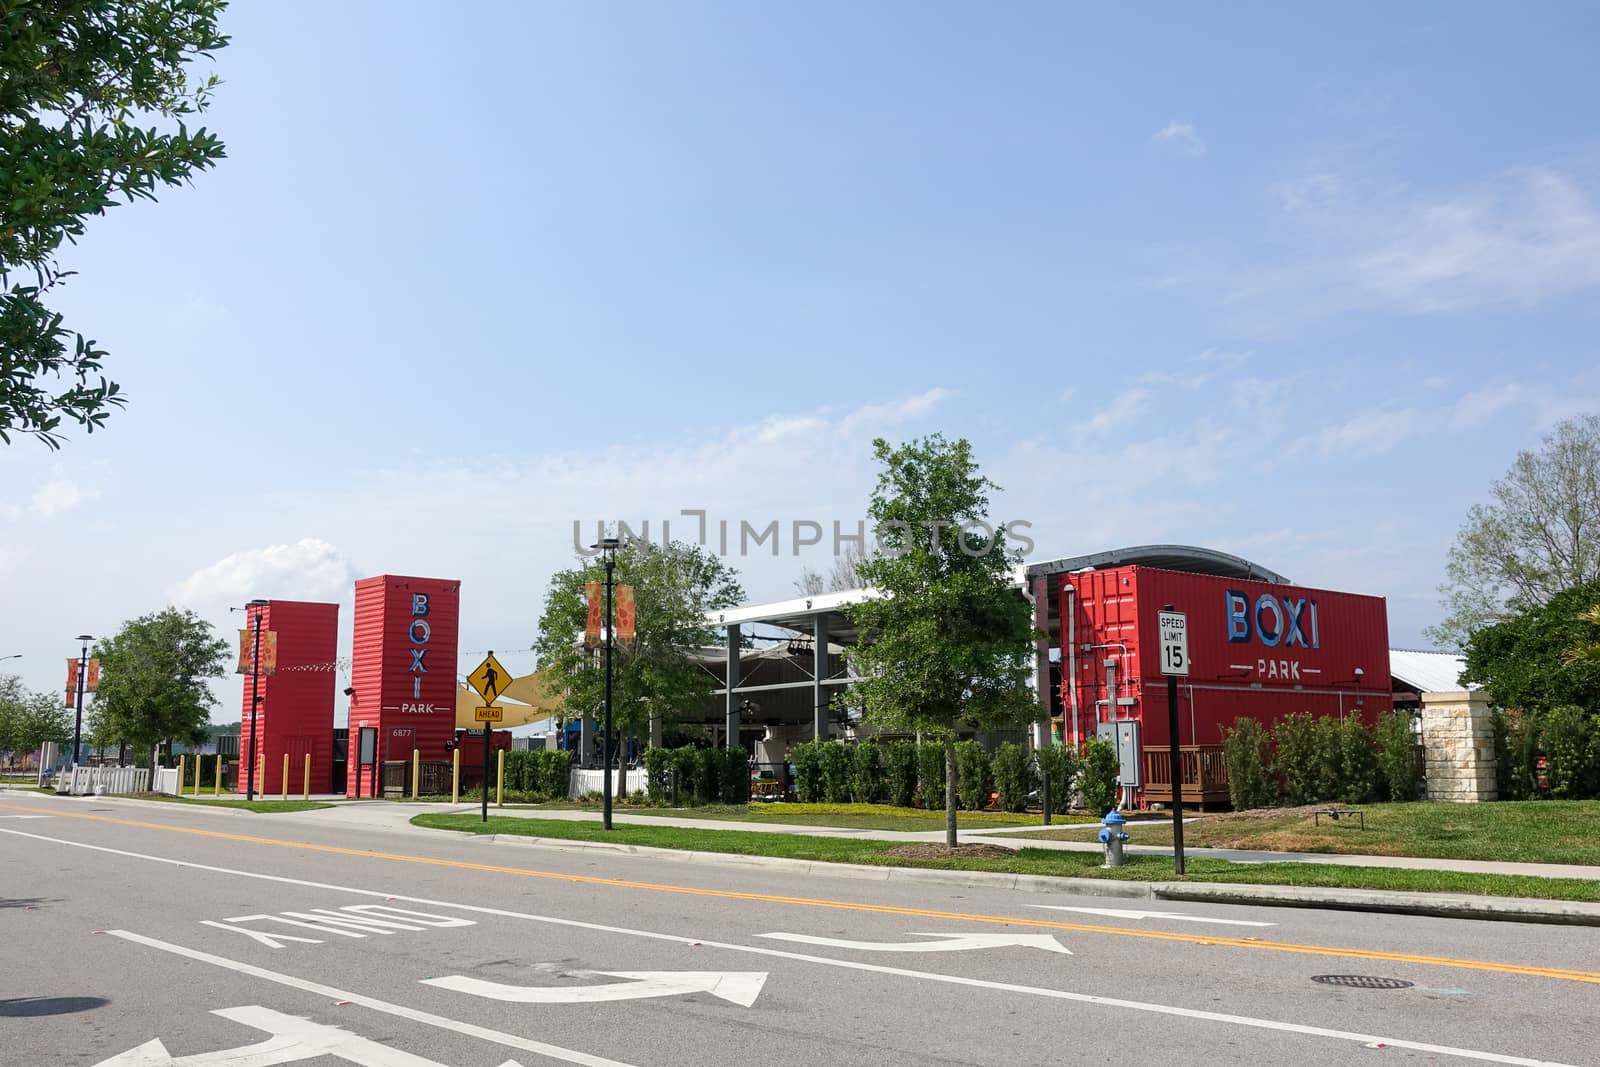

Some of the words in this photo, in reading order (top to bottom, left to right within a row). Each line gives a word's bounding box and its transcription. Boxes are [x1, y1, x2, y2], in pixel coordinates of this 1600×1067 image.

[1161, 617, 1184, 629] SPEED
[1225, 589, 1320, 649] BOXI
[1164, 631, 1182, 642] LIMIT
[408, 592, 431, 700] BOXI
[1165, 645, 1183, 668] 15
[1257, 659, 1300, 680] PARK
[401, 703, 434, 713] PARK
[478, 710, 500, 718] AHEAD
[393, 729, 411, 737] 6877
[199, 905, 478, 949] ONLY
